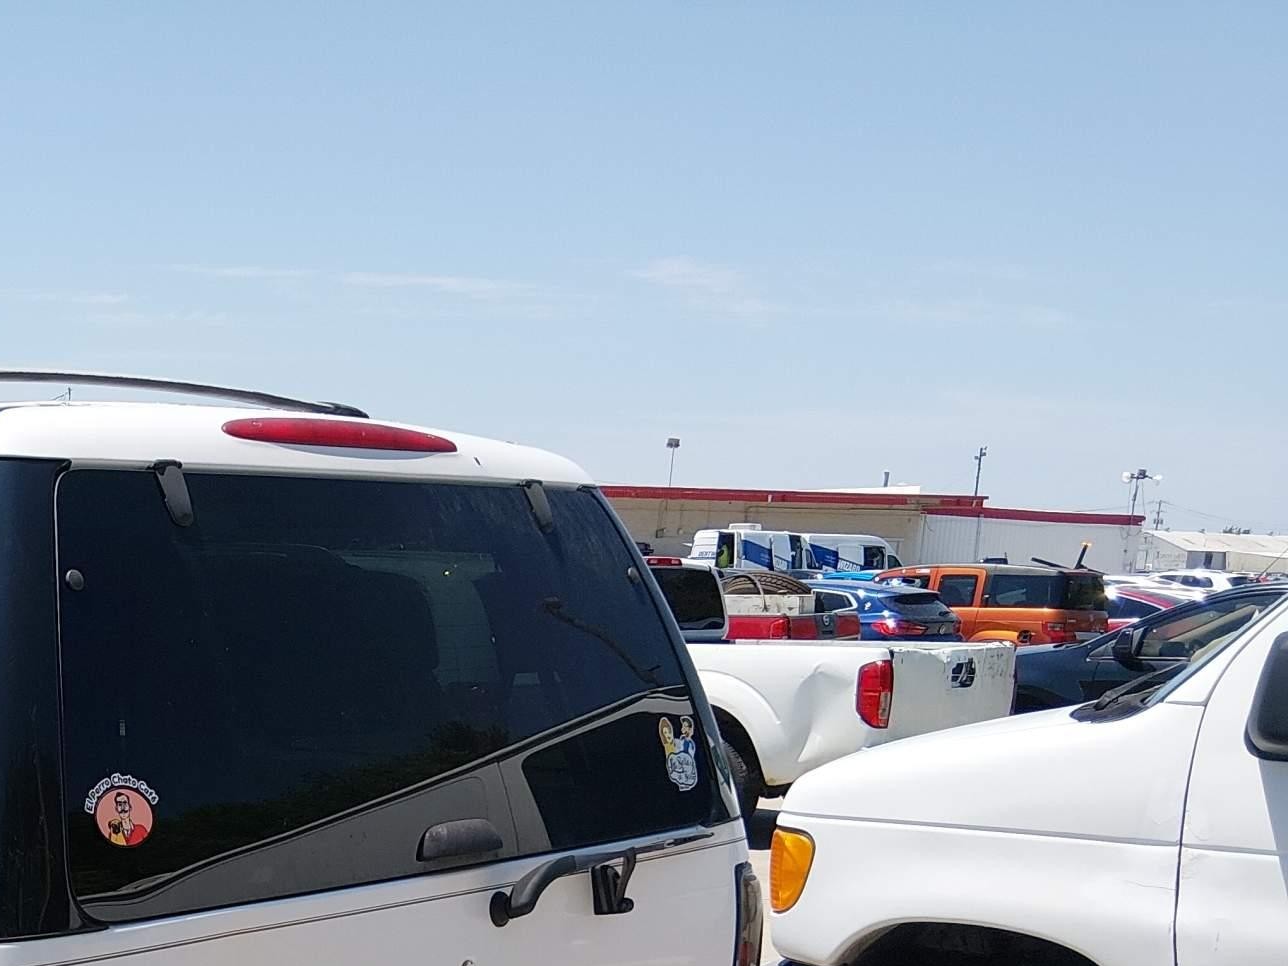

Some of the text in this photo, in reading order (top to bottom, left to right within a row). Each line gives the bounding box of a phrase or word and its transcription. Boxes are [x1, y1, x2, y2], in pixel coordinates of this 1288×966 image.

[85, 798, 94, 812] El
[90, 778, 110, 799] Perro
[111, 774, 137, 787] Chato
